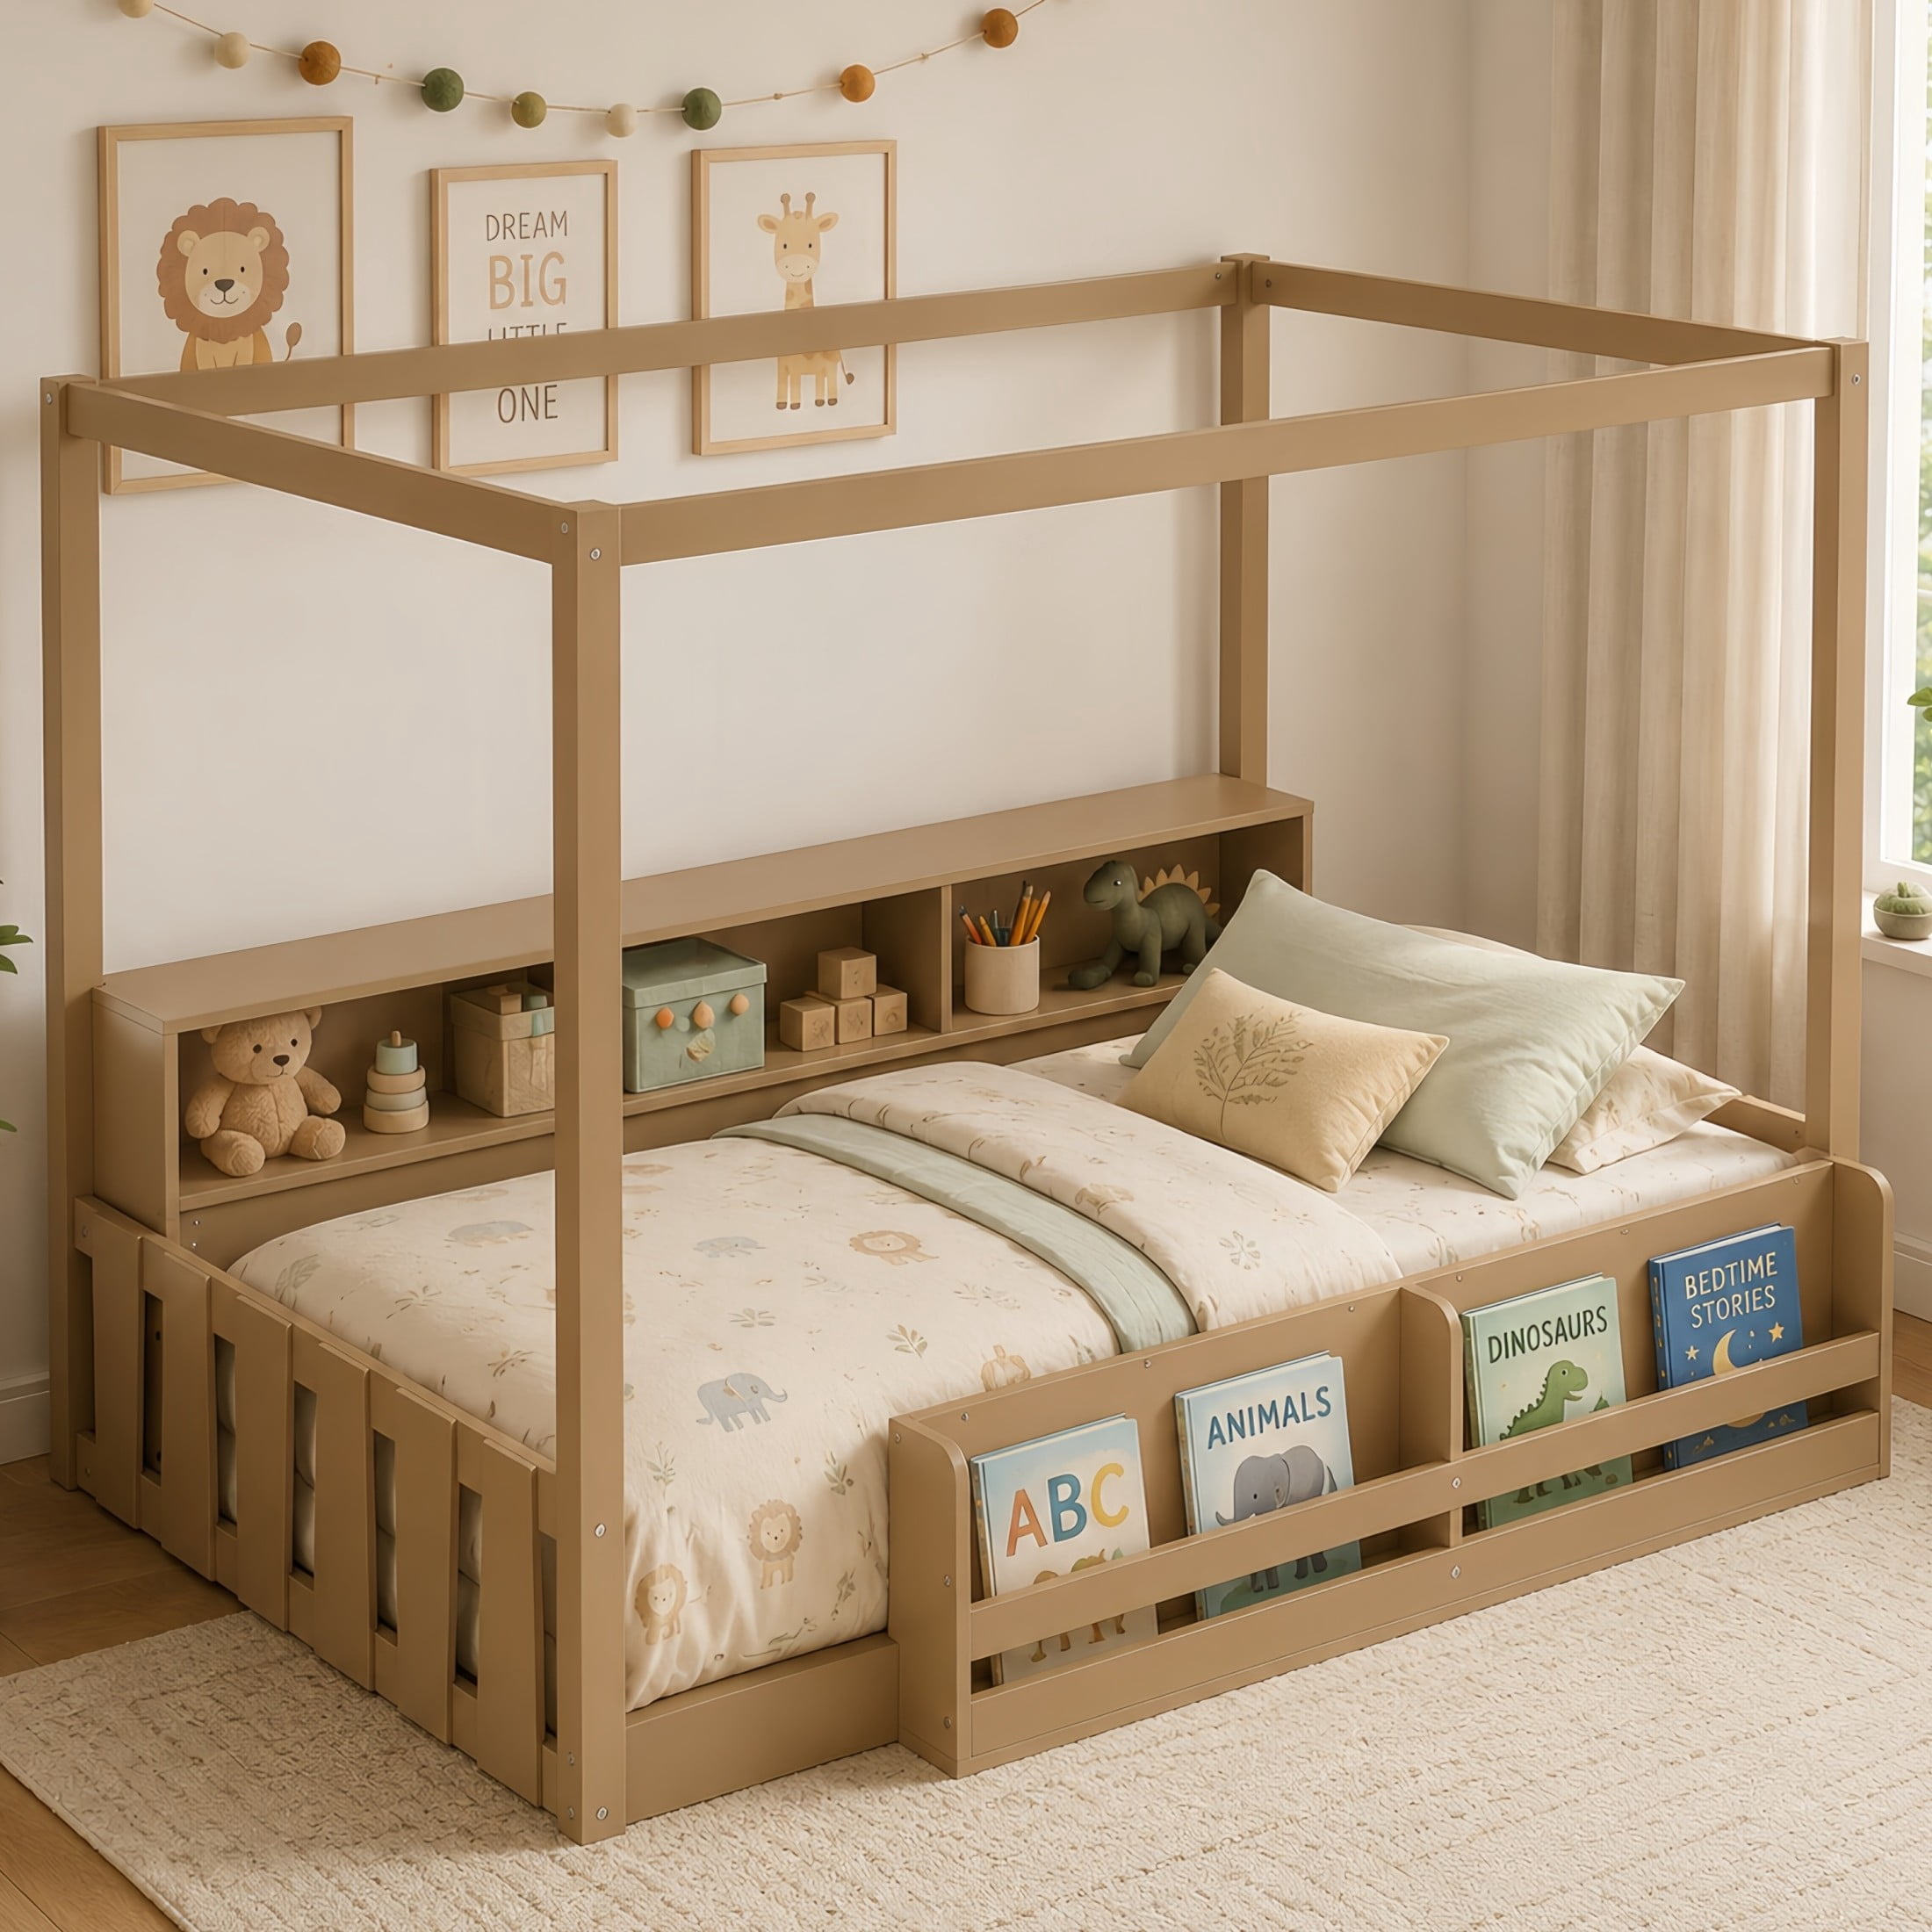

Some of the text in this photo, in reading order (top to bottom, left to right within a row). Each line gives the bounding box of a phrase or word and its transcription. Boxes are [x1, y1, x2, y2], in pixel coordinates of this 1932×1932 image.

[486, 210, 568, 242] DREAM
[488, 251, 567, 310] BIG
[497, 385, 559, 423] ONE
[1684, 1251, 1778, 1301] BEDTIME
[1690, 1285, 1776, 1329] STORIES
[1488, 1305, 1608, 1364] DINOSAURS
[1208, 1386, 1331, 1450] ANIMALS
[1006, 1462, 1130, 1557] ABC
